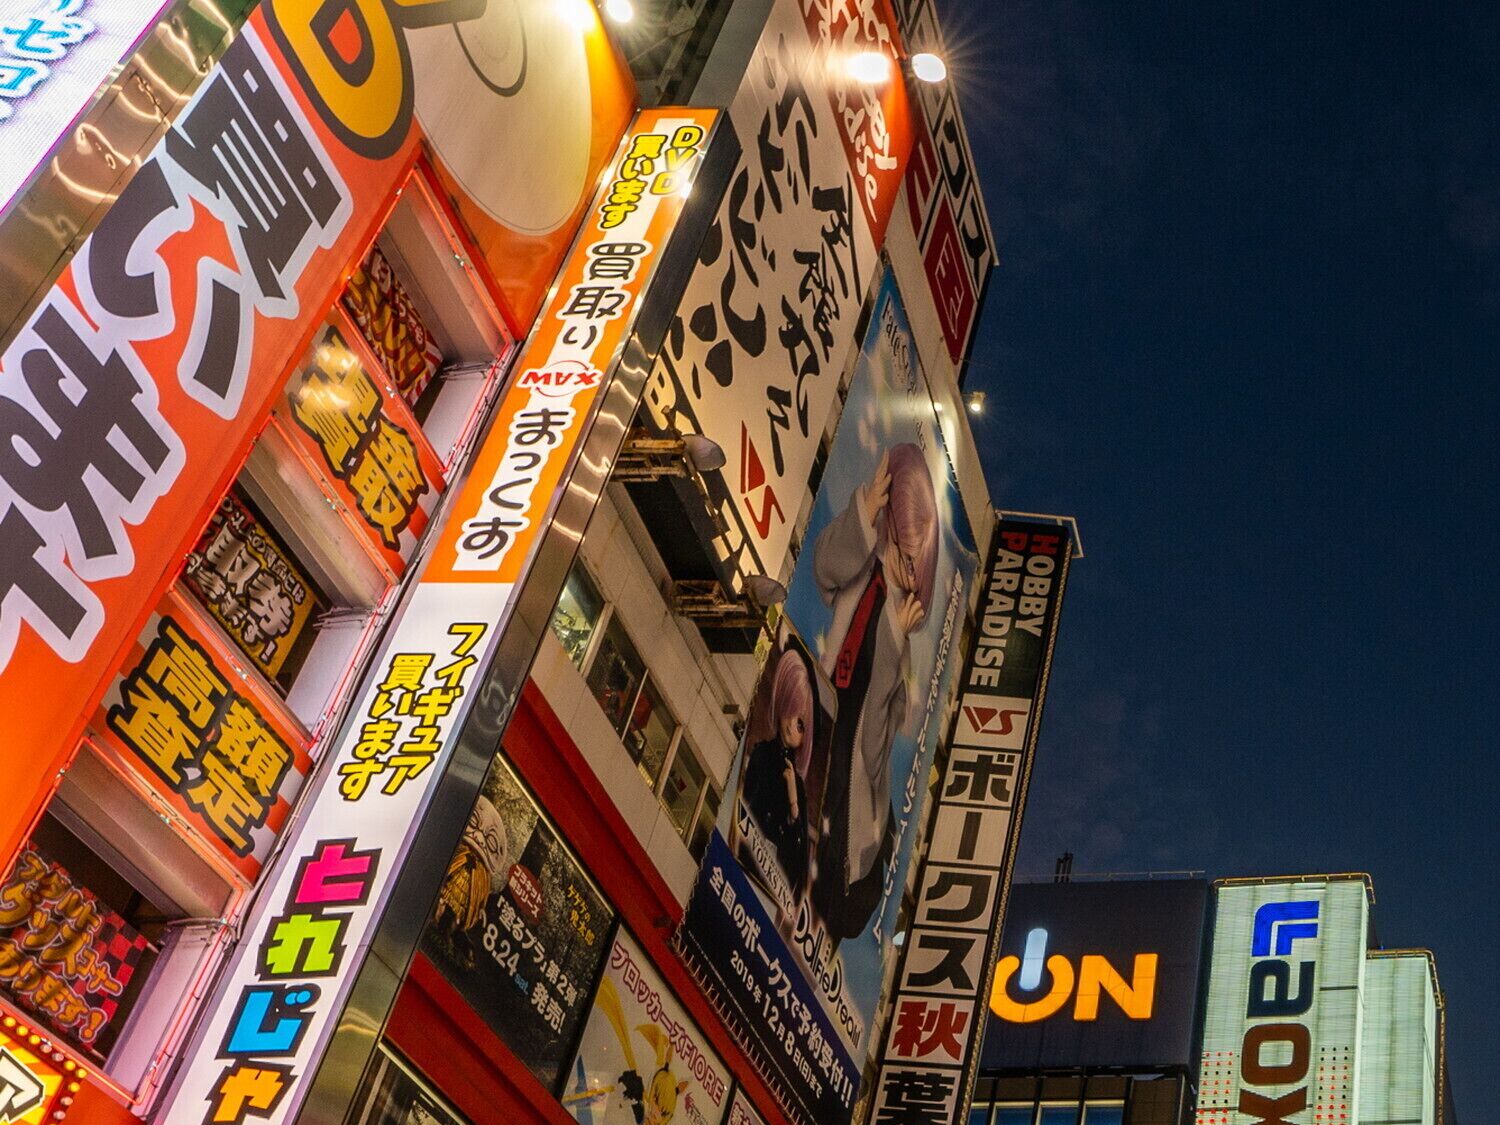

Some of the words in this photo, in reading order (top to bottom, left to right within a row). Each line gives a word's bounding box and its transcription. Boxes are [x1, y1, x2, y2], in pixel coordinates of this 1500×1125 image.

[600, 134, 667, 228] 買います
[650, 126, 702, 195] DVD
[566, 243, 646, 350] 買取り
[462, 408, 570, 559] まっくす
[970, 529, 1023, 688] PARADISE
[1018, 533, 1057, 638] HOBBY
[108, 680, 266, 856] 査定
[128, 618, 292, 797] 高額
[338, 652, 436, 802] 買います
[385, 622, 488, 796] フィギュア
[483, 923, 520, 977] 8.24
[530, 980, 567, 1034] 発売!
